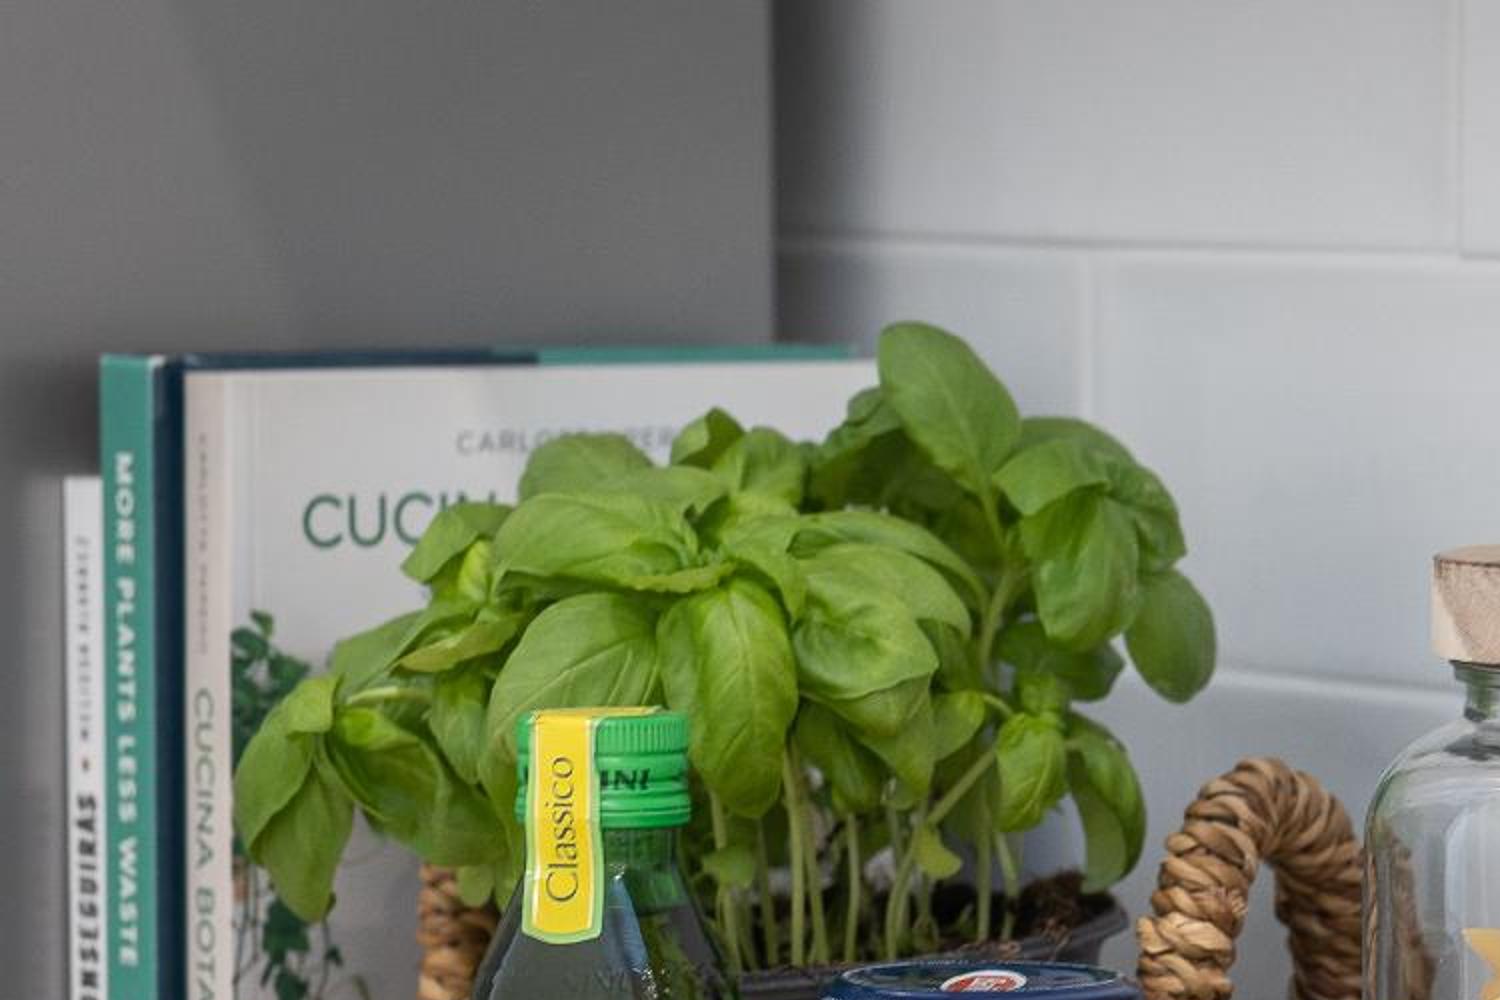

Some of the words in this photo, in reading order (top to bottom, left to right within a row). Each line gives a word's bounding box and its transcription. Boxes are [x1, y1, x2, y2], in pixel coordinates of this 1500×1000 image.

[115, 451, 134, 566] MORE
[117, 577, 136, 722] PLANTS
[117, 735, 137, 824] LESS
[194, 687, 215, 869] CUCINA
[545, 756, 579, 902] Classico
[118, 835, 139, 967] WASTE
